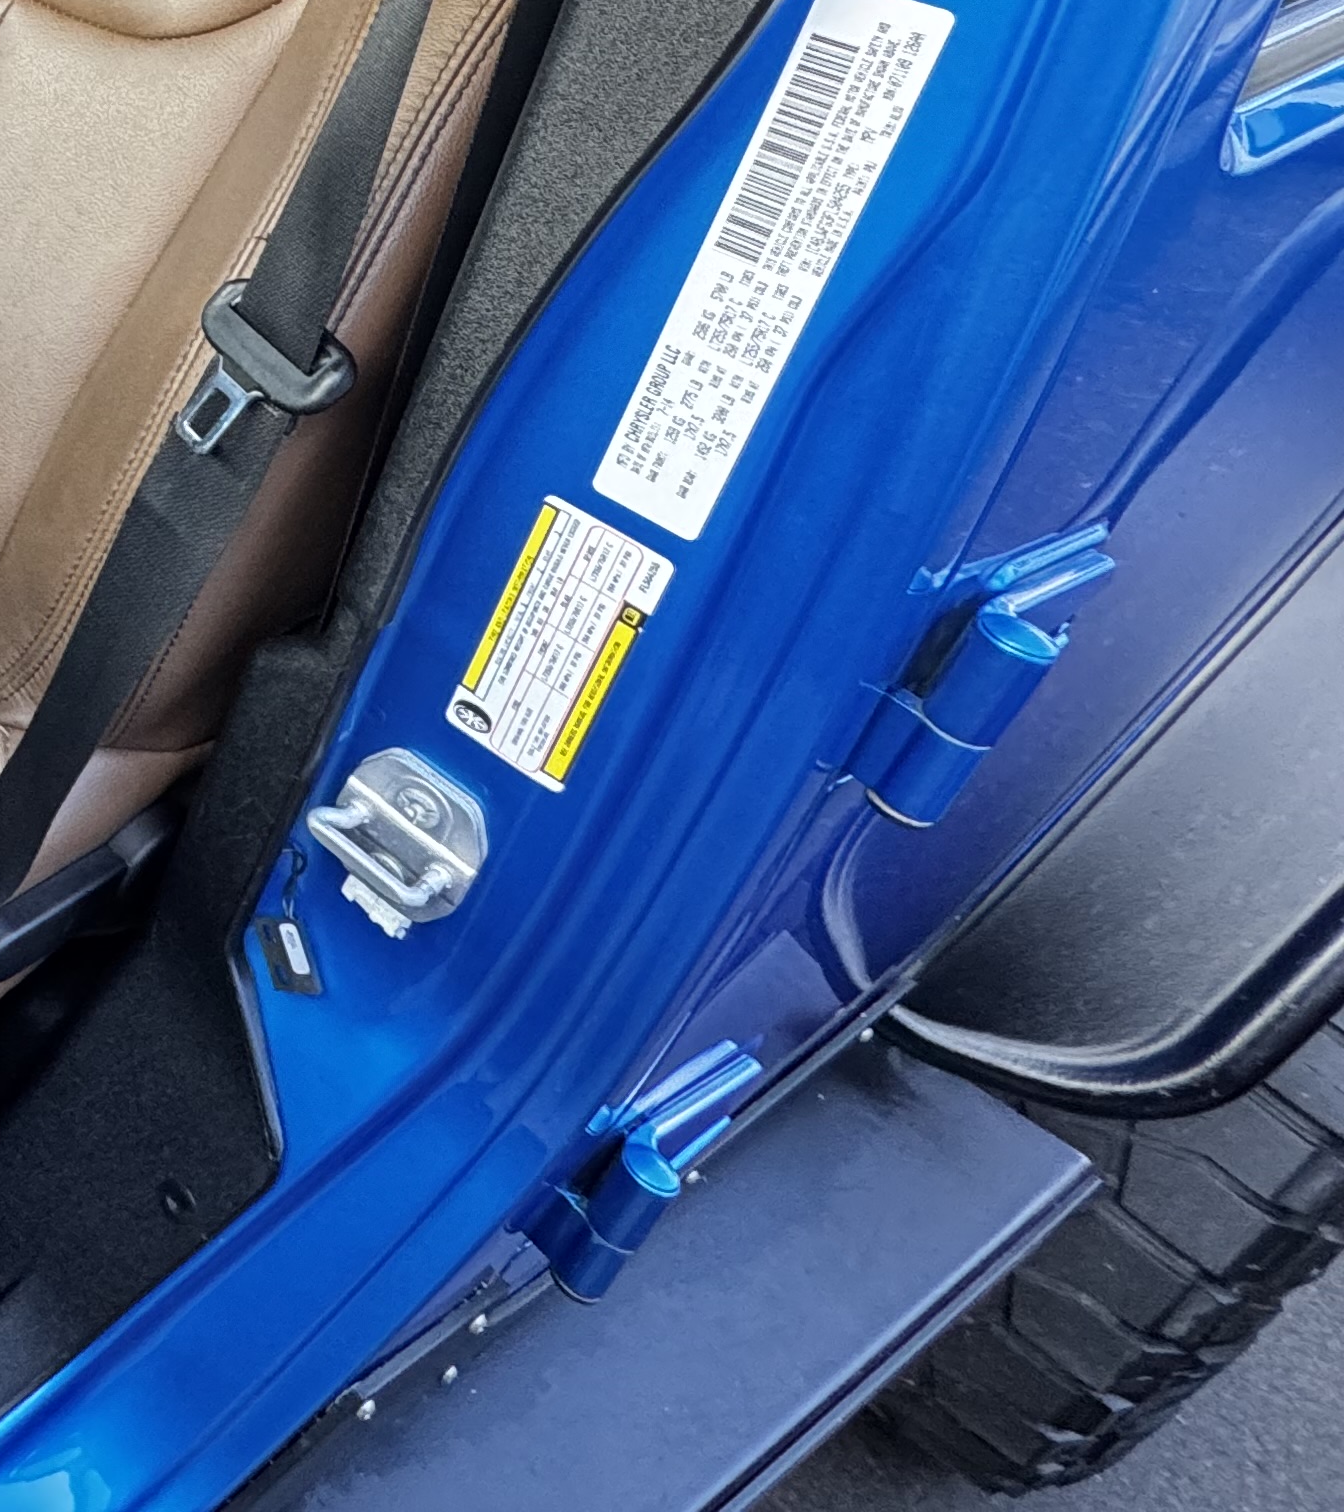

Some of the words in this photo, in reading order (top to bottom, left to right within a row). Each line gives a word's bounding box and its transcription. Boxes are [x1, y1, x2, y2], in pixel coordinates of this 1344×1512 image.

[623, 395, 658, 443] CHRYSLER
[645, 363, 672, 397] GROUP
[660, 344, 682, 365] LLC
